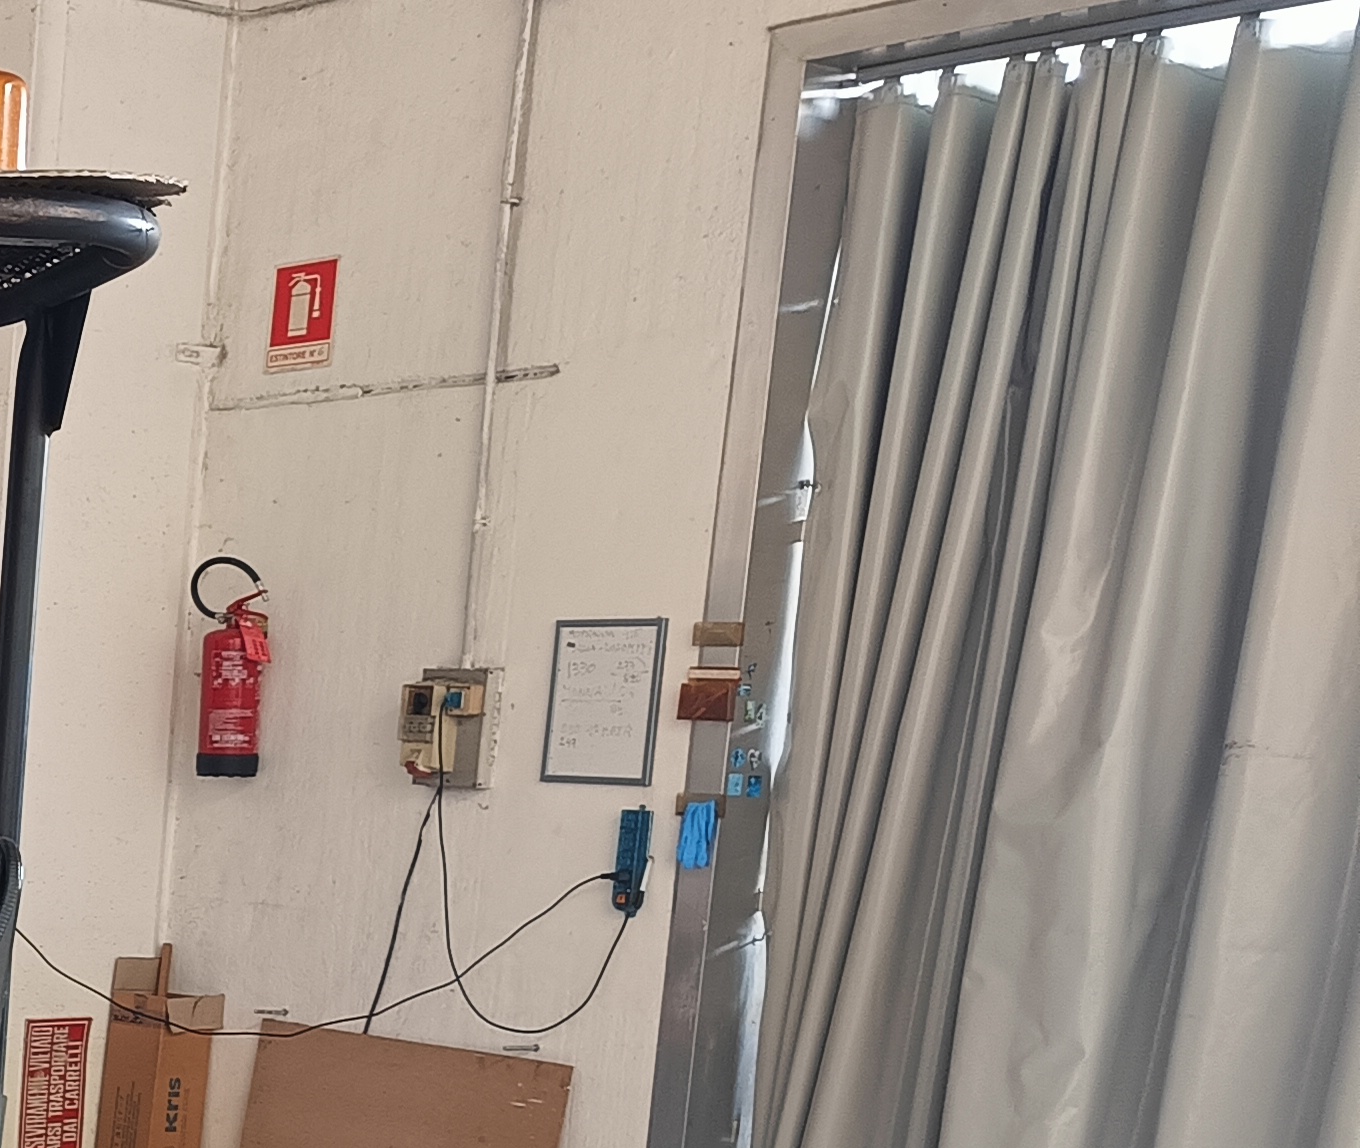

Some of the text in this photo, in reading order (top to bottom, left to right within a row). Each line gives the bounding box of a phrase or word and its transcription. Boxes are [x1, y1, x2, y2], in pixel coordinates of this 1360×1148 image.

[269, 350, 307, 363] ESTINTORE
[28, 1027, 54, 1071] VIETATO
[48, 1026, 69, 1118] TRASPORTARE
[63, 1041, 83, 1143] DAI CARRELLI
